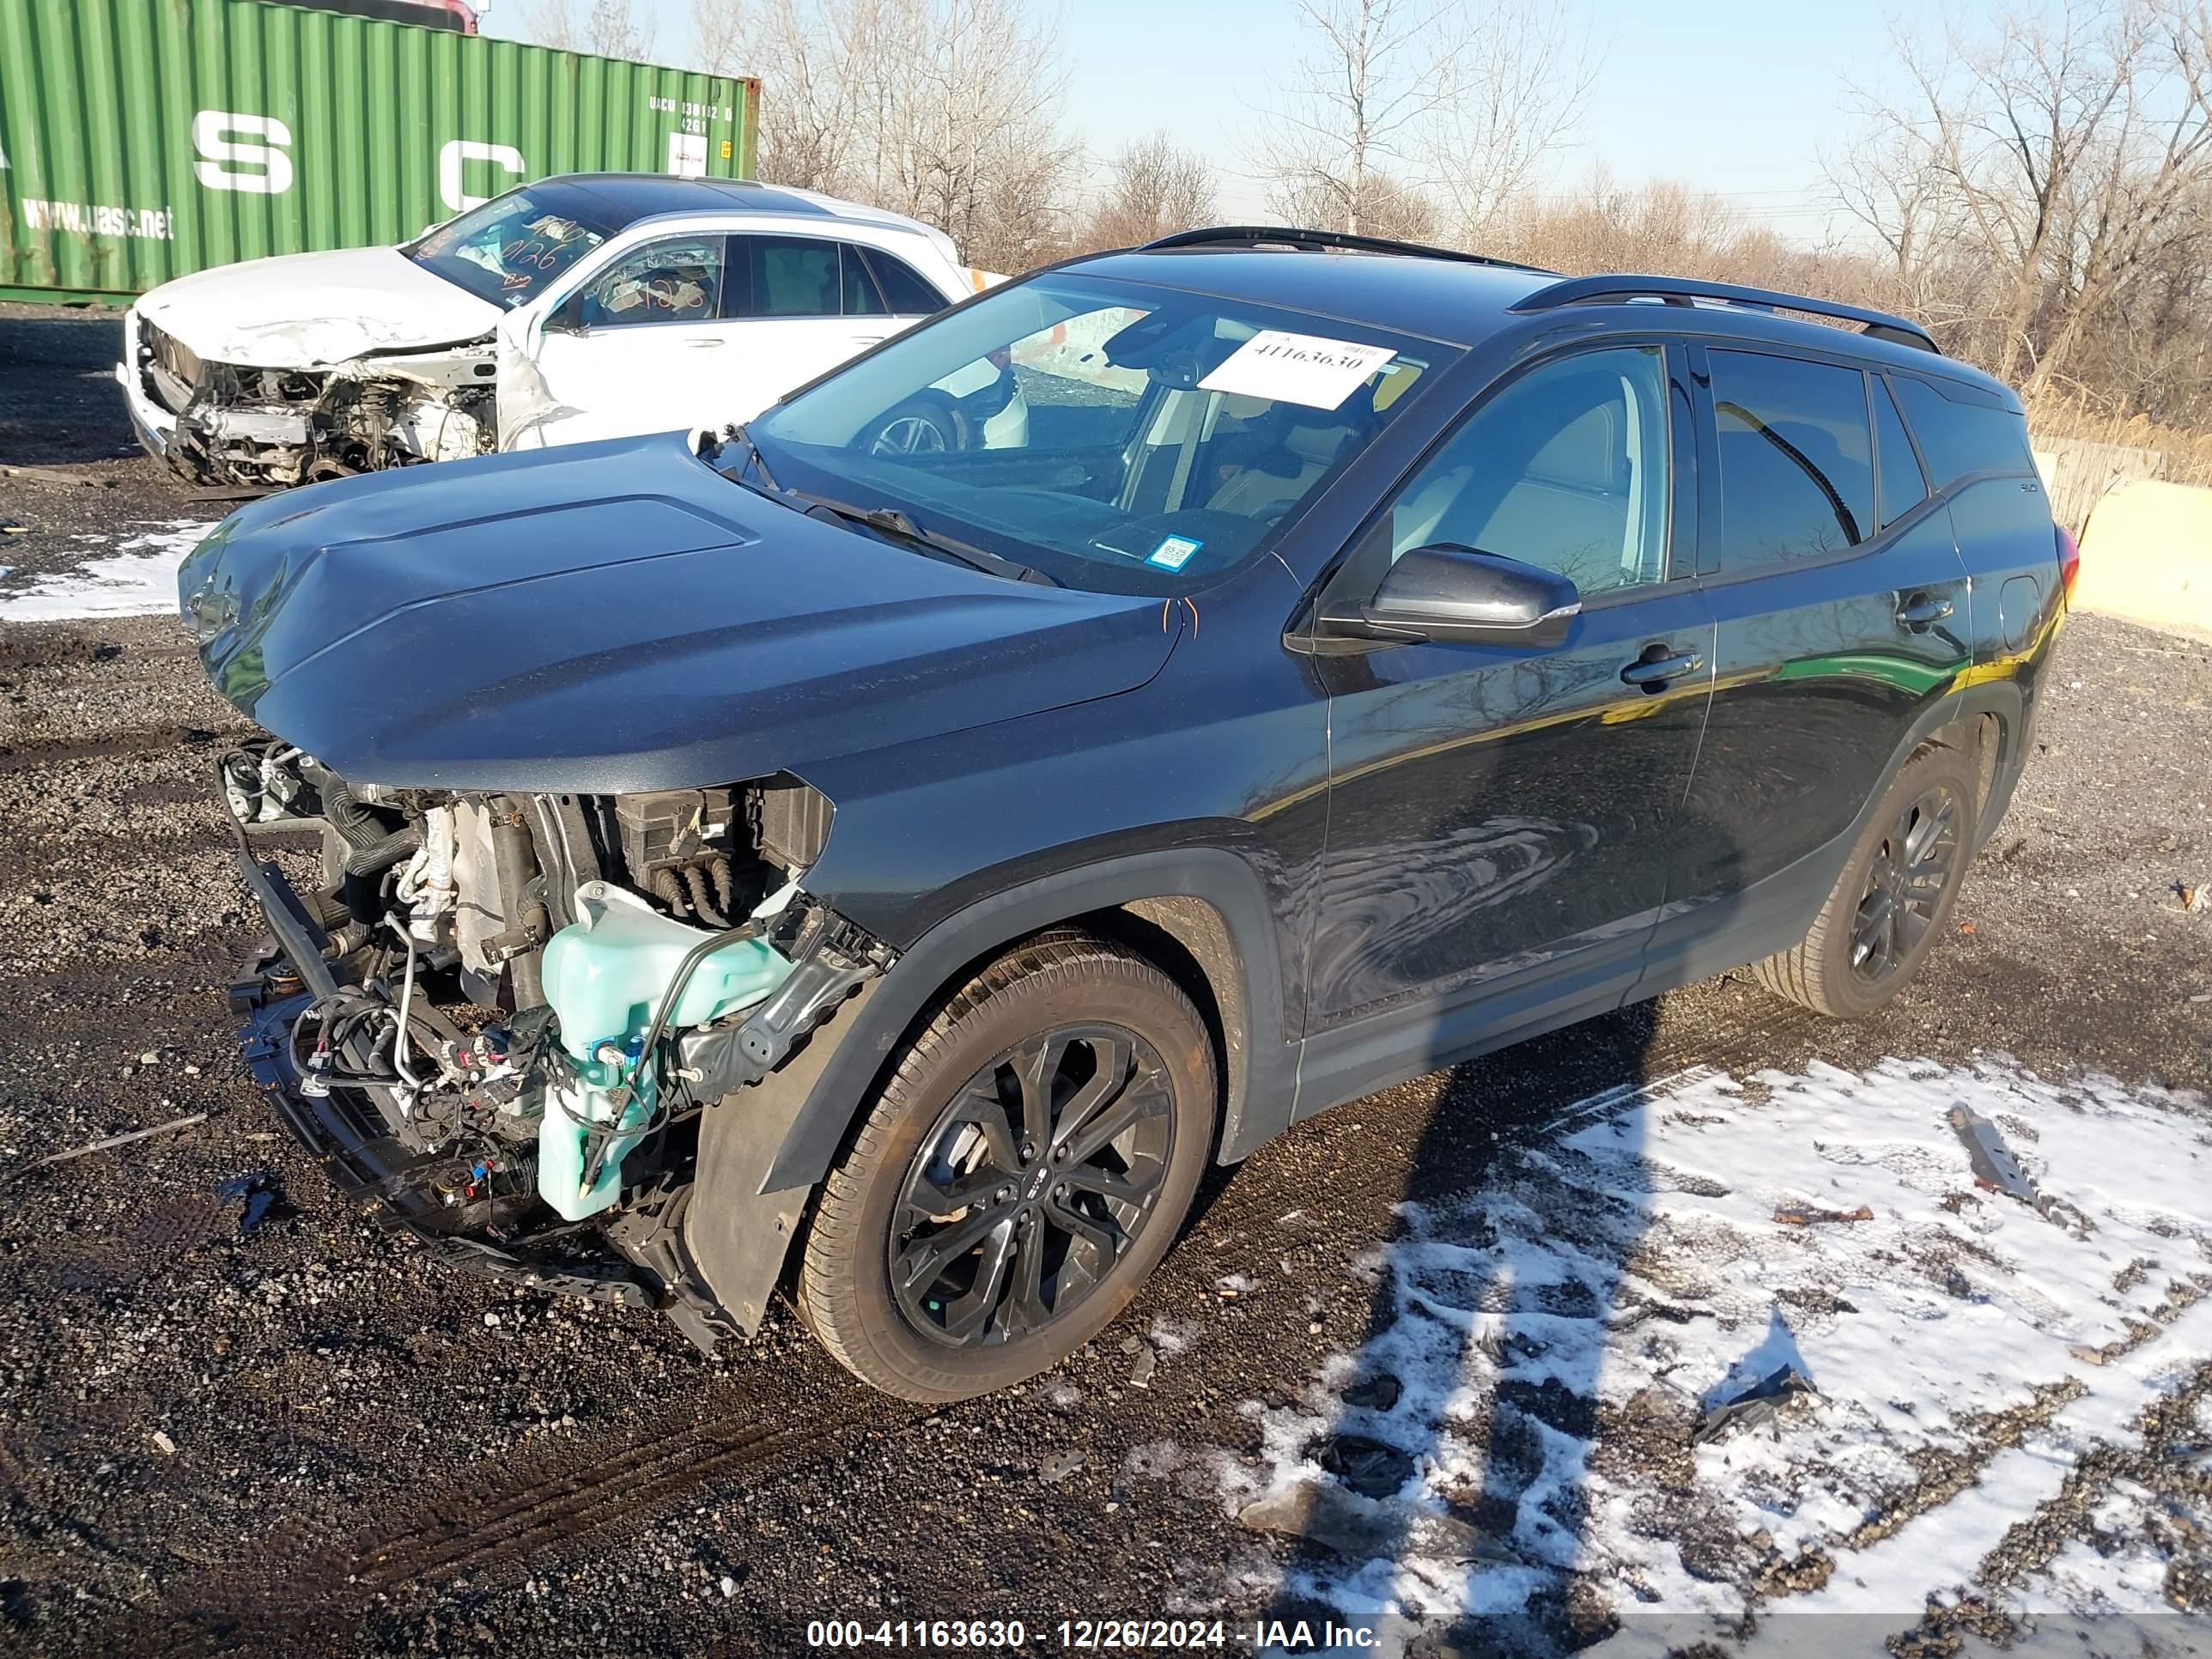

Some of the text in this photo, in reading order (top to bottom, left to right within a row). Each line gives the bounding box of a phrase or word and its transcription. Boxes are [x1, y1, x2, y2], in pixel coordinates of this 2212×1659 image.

[649, 96, 675, 112] UACU
[681, 118, 707, 133] 42G1
[22, 198, 174, 240] www.uasc.net
[501, 240, 568, 270] 0126
[1255, 344, 1363, 369] 41163630
